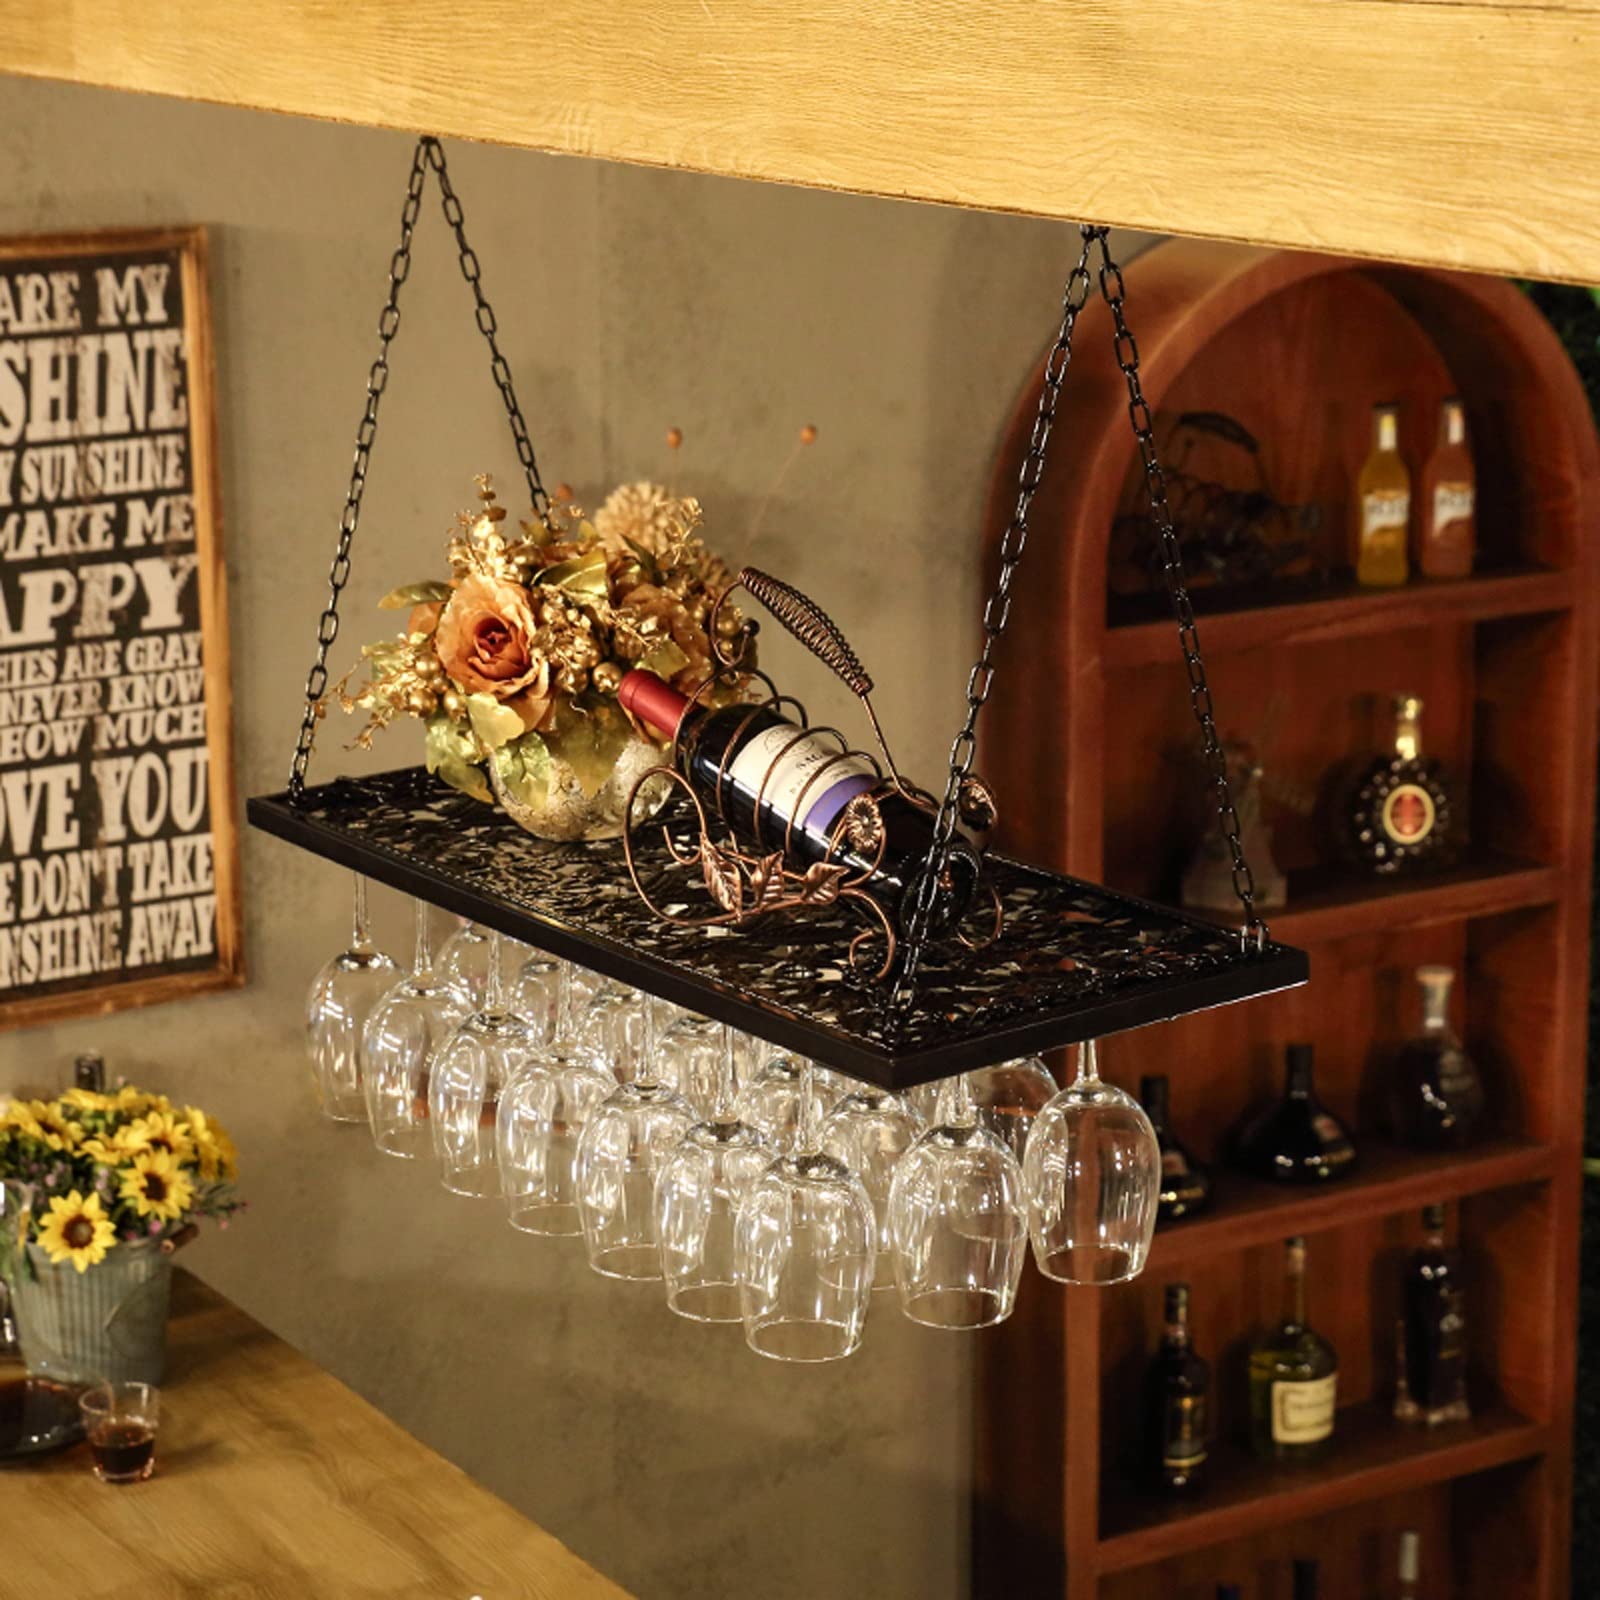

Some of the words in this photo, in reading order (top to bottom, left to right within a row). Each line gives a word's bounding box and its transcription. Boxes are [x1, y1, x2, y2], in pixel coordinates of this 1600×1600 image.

[95, 264, 170, 327] MY
[20, 434, 185, 504] SUNSHINE
[123, 495, 195, 547] ME
[60, 640, 122, 683] ARE
[125, 631, 202, 675] GRAY
[0, 681, 103, 726] NEVER
[109, 667, 205, 714] KNOW
[0, 718, 87, 764] HOW
[92, 703, 206, 752] MUCH
[91, 747, 209, 843] YOU
[20, 846, 122, 920] DON'T
[128, 833, 214, 902] TAKE
[125, 895, 217, 968] AWAY
